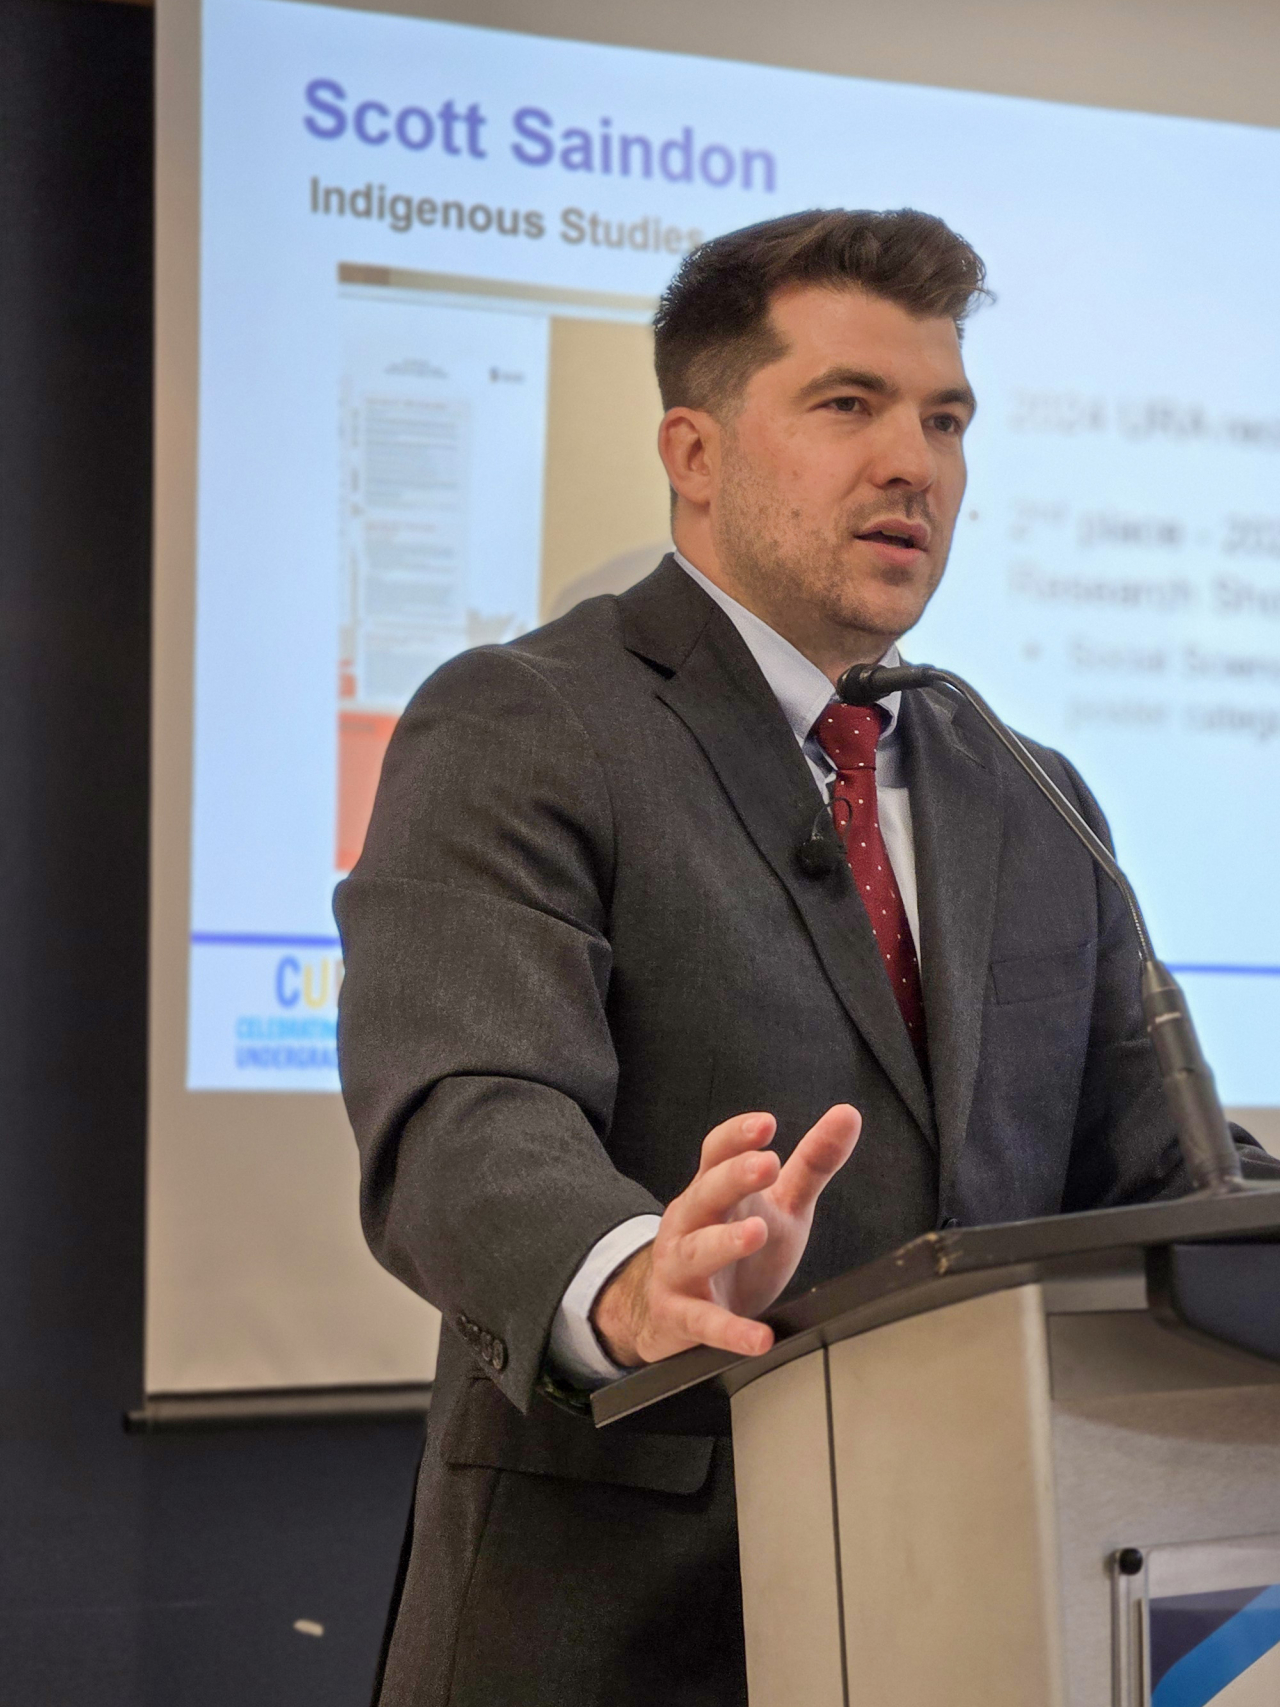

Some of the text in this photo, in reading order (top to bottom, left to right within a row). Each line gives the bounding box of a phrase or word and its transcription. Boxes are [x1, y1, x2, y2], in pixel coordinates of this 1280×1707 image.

[302, 76, 778, 194] Scott Saindon
[310, 175, 702, 256] Indigenous Studies
[1077, 504, 1185, 555] place
[1008, 558, 1193, 606] Research
[274, 955, 346, 1010] CU
